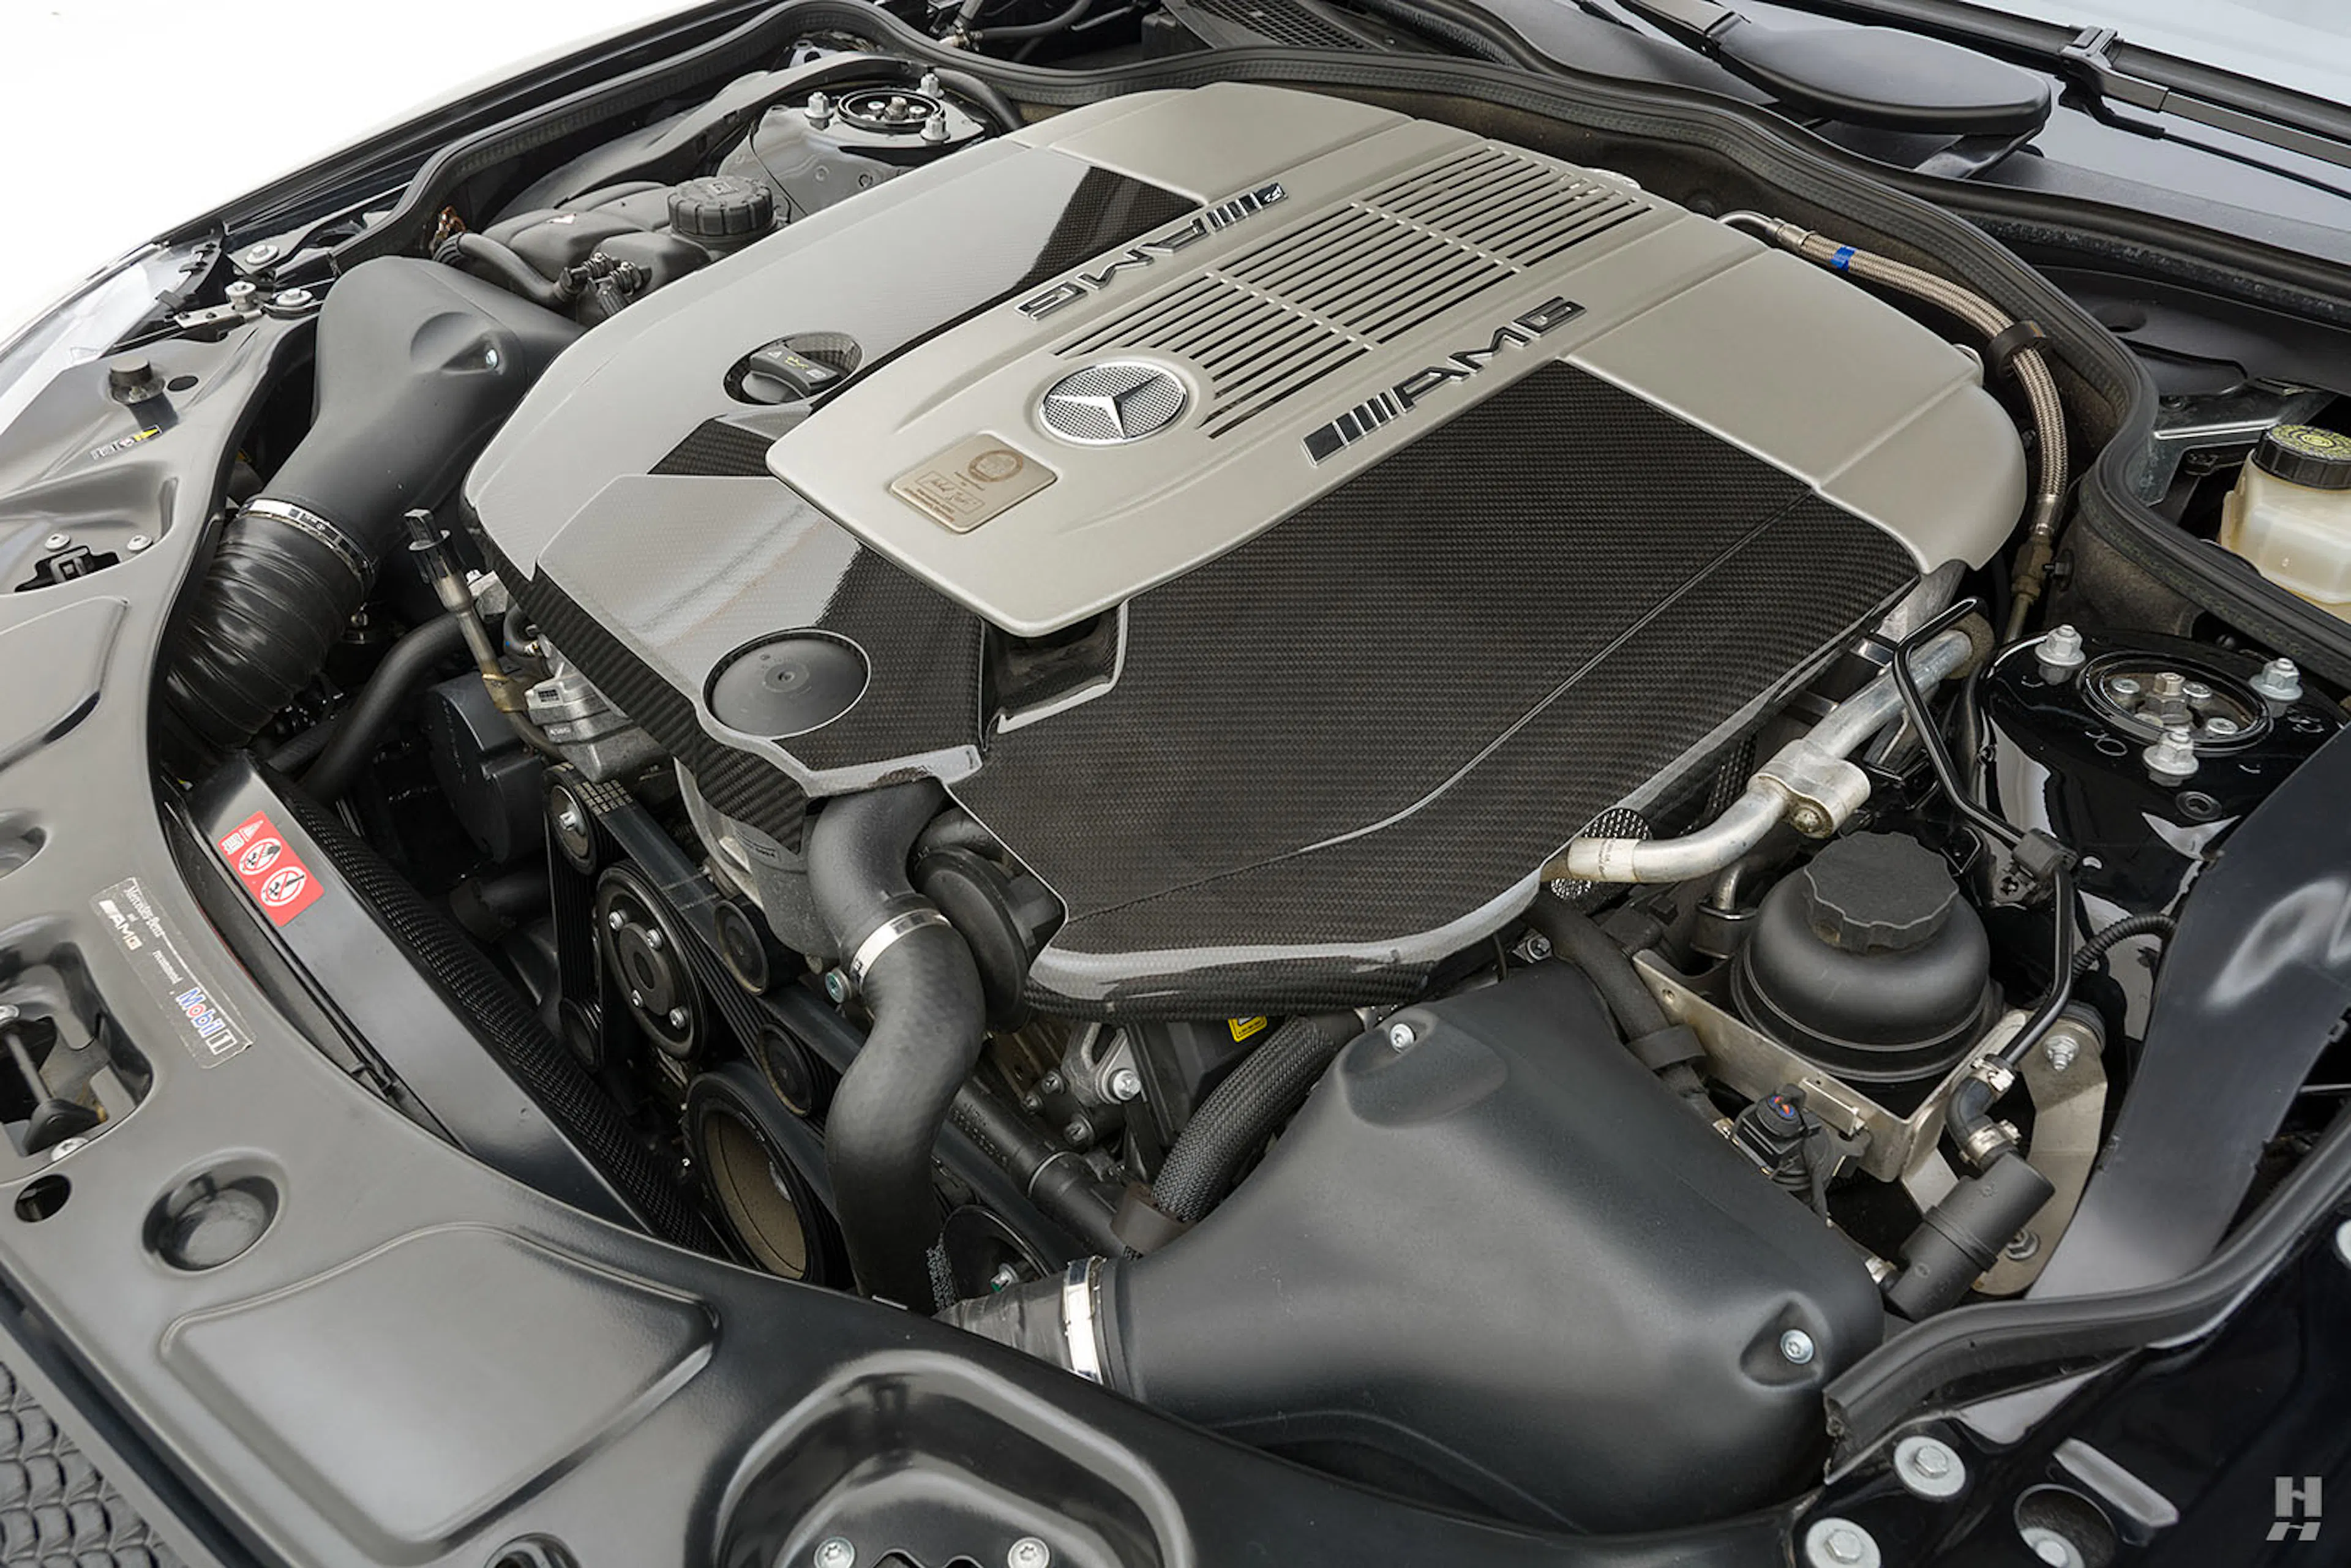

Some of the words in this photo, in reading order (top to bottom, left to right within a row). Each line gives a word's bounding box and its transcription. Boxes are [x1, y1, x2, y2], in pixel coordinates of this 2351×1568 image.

[1014, 216, 1210, 321] AMG
[110, 914, 142, 950] AMG
[176, 987, 225, 1038] Mobil
[206, 1029, 237, 1056] 1
